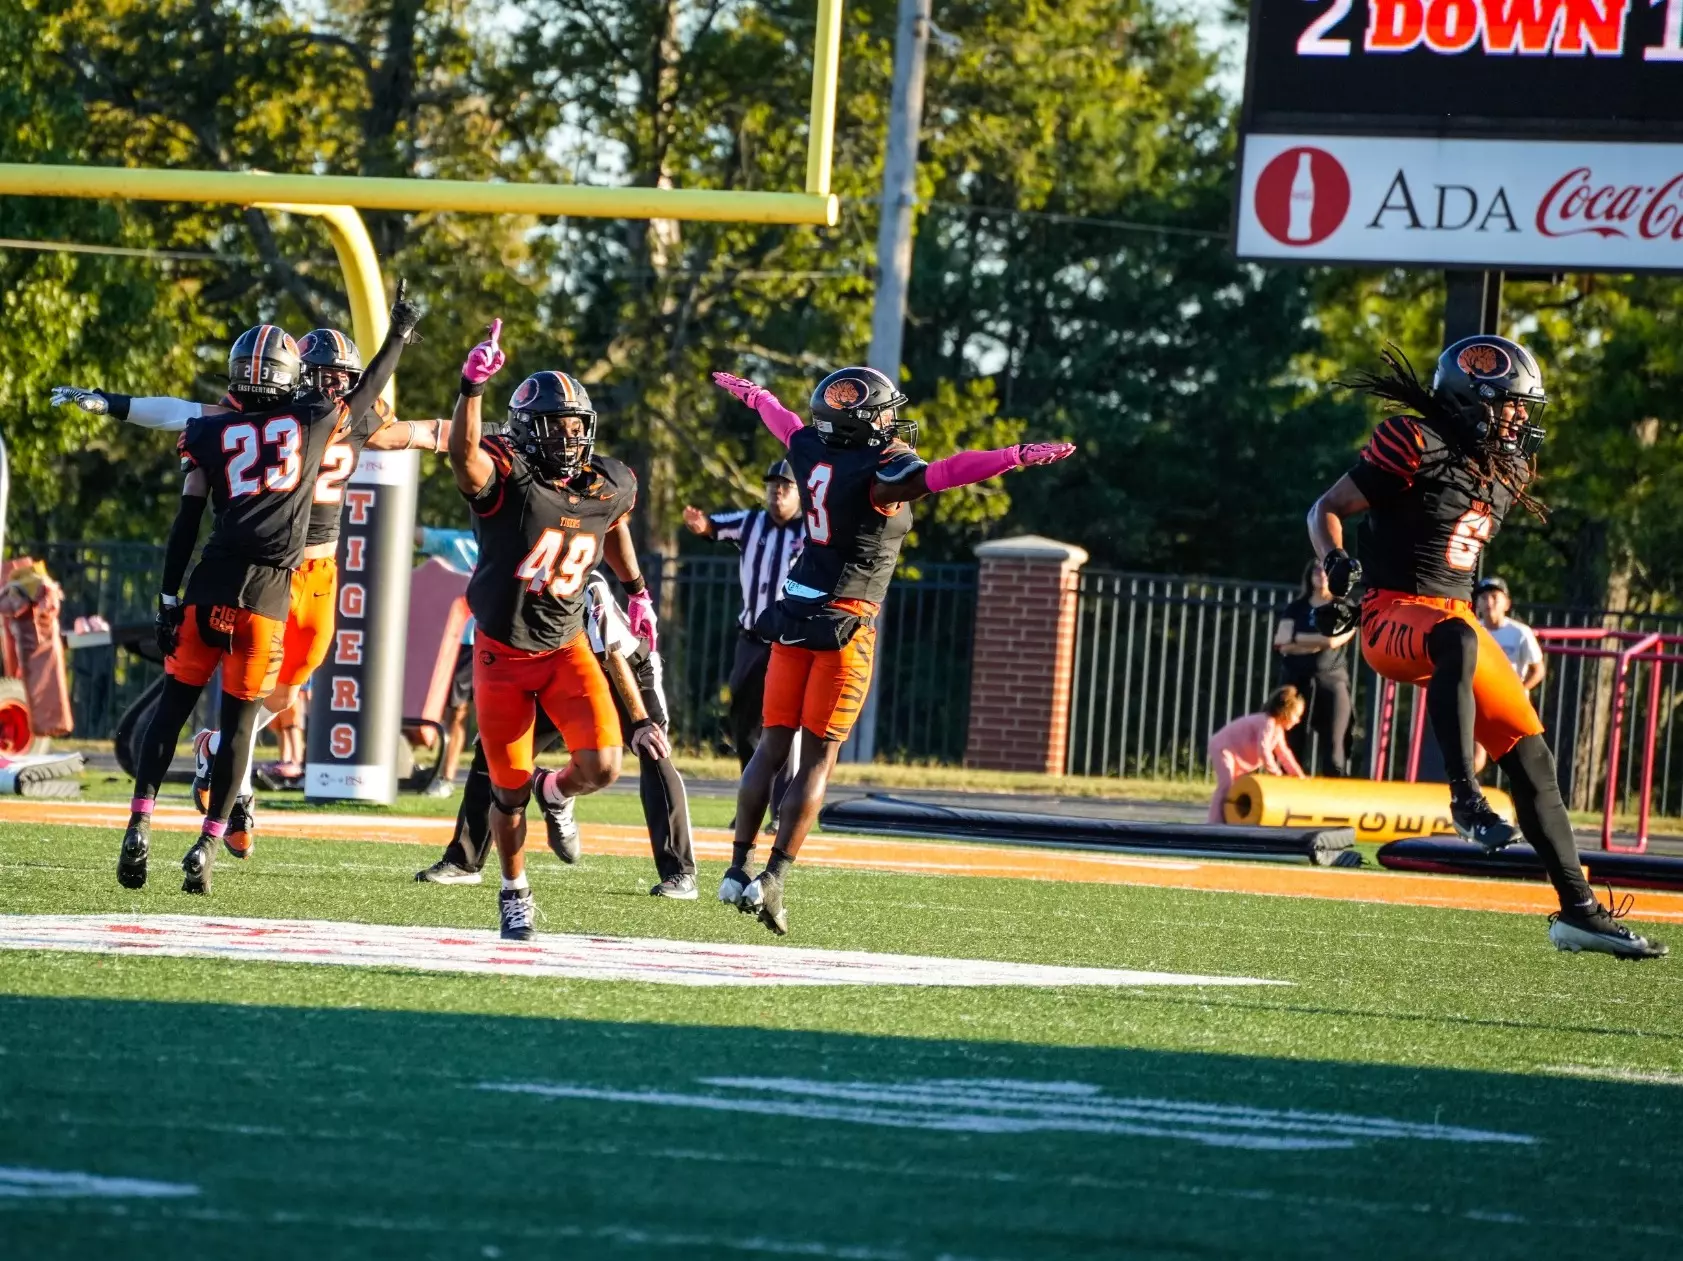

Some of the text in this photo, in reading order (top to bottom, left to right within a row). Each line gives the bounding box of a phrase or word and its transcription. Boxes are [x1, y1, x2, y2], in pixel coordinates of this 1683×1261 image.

[1297, 0, 1350, 55] 2
[1365, 0, 1632, 56] DOWN
[237, 384, 277, 395] EAST CENTRAL
[221, 415, 303, 499] 23
[807, 462, 833, 546] 3
[514, 528, 598, 598] 49
[329, 489, 376, 759] TIGERS
